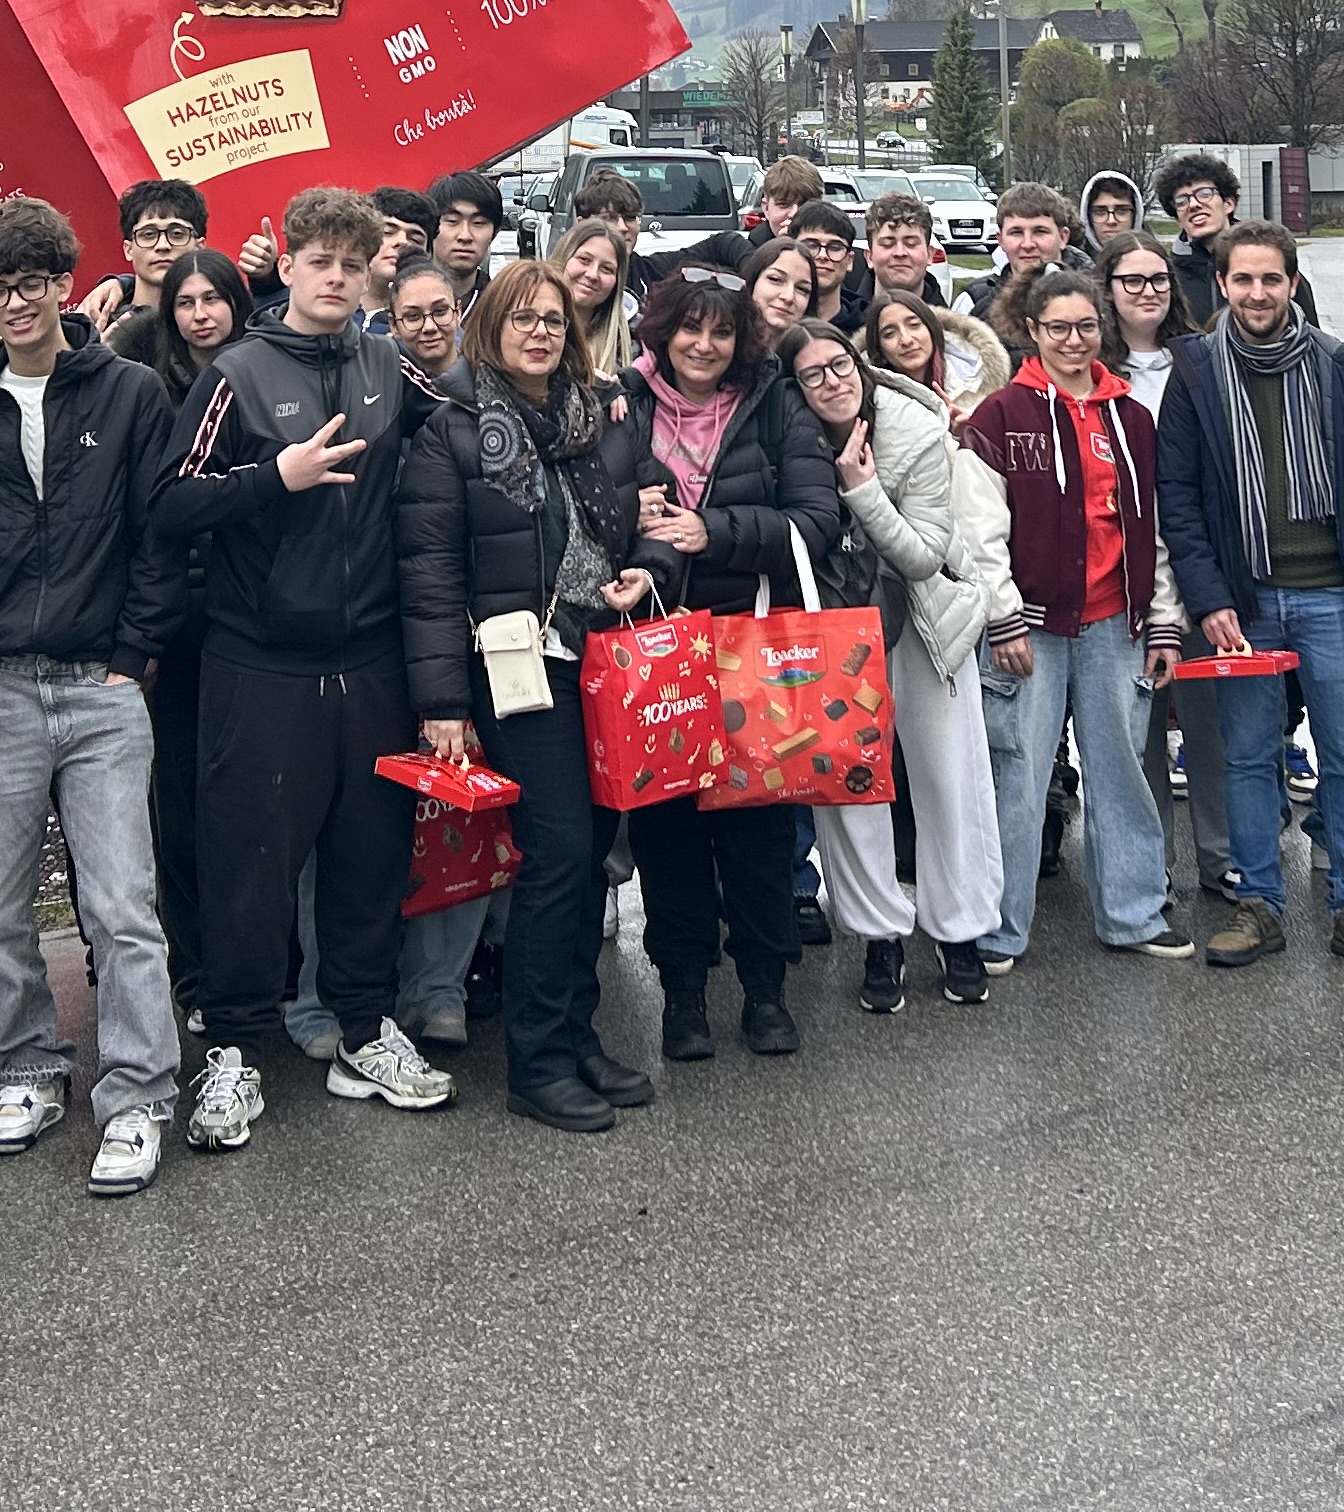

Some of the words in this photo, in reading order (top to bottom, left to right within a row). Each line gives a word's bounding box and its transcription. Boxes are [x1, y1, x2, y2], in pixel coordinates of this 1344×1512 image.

[383, 23, 430, 65] NON
[208, 71, 235, 88] with
[398, 55, 437, 84] GMO
[166, 78, 284, 127] HAZELNUTS
[208, 109, 240, 128] from
[241, 104, 261, 119] our
[394, 117, 425, 146] Che
[424, 89, 477, 131] bontà!
[166, 110, 313, 167] SUSTAINABILITY
[226, 140, 269, 165] project
[760, 644, 819, 667] Loacker
[642, 701, 671, 726] 100
[670, 695, 704, 717] YEARS
